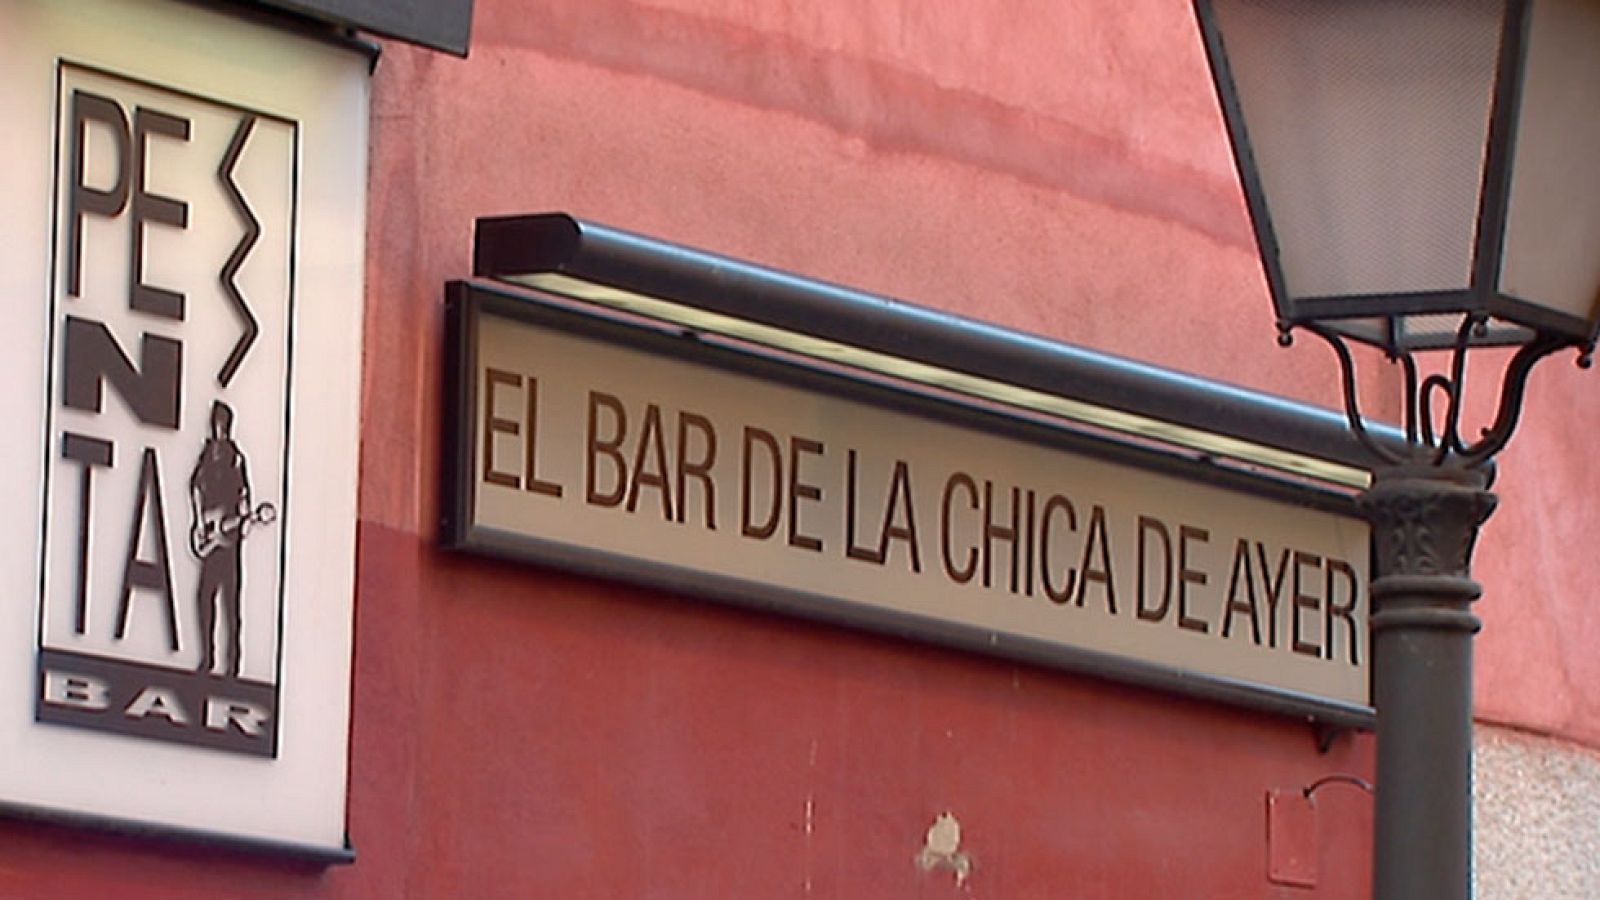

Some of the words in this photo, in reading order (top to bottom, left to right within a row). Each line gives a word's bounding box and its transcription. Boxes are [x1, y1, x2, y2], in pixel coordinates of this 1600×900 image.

[483, 368, 563, 498] EL
[586, 390, 718, 531] BAR
[741, 425, 824, 553] DE
[845, 449, 921, 574] LA
[941, 472, 1117, 615] CHICA
[1136, 515, 1210, 633] DE
[1221, 538, 1358, 666] AYER
[44, 670, 272, 736] BAR
